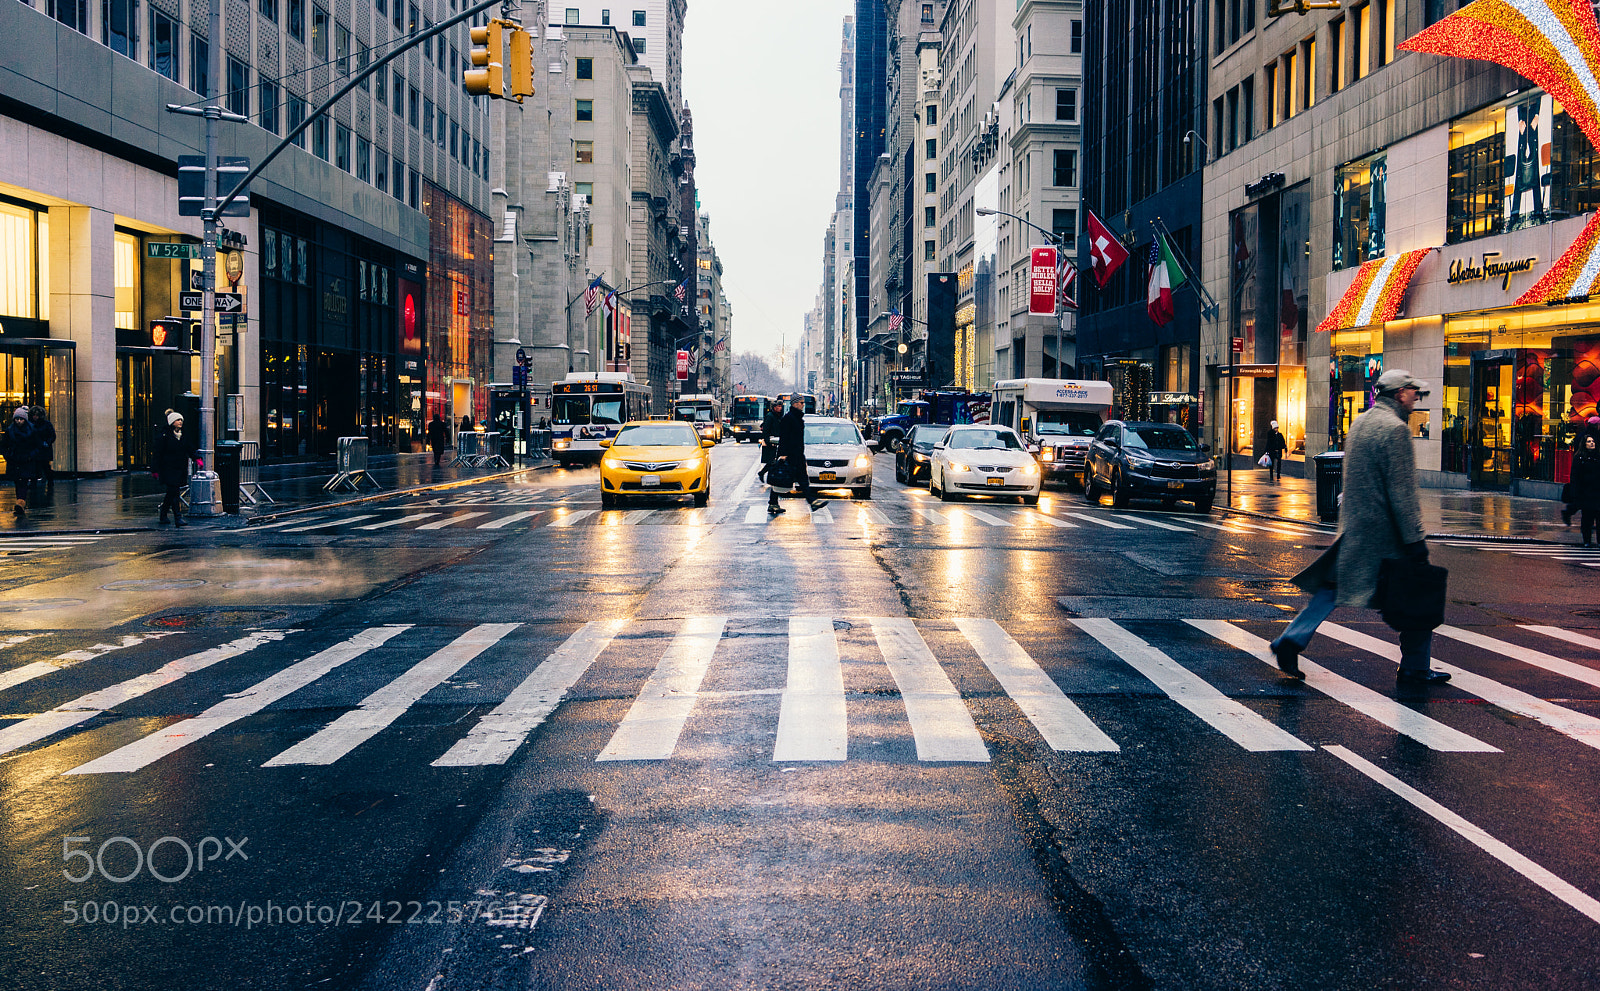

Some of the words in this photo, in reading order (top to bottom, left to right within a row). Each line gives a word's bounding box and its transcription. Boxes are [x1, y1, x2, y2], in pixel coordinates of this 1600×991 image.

[150, 244, 160, 256] W
[164, 245, 179, 257] 52
[1033, 265, 1055, 273] BETTE
[184, 297, 202, 306] ONE
[215, 298, 234, 307] WAY
